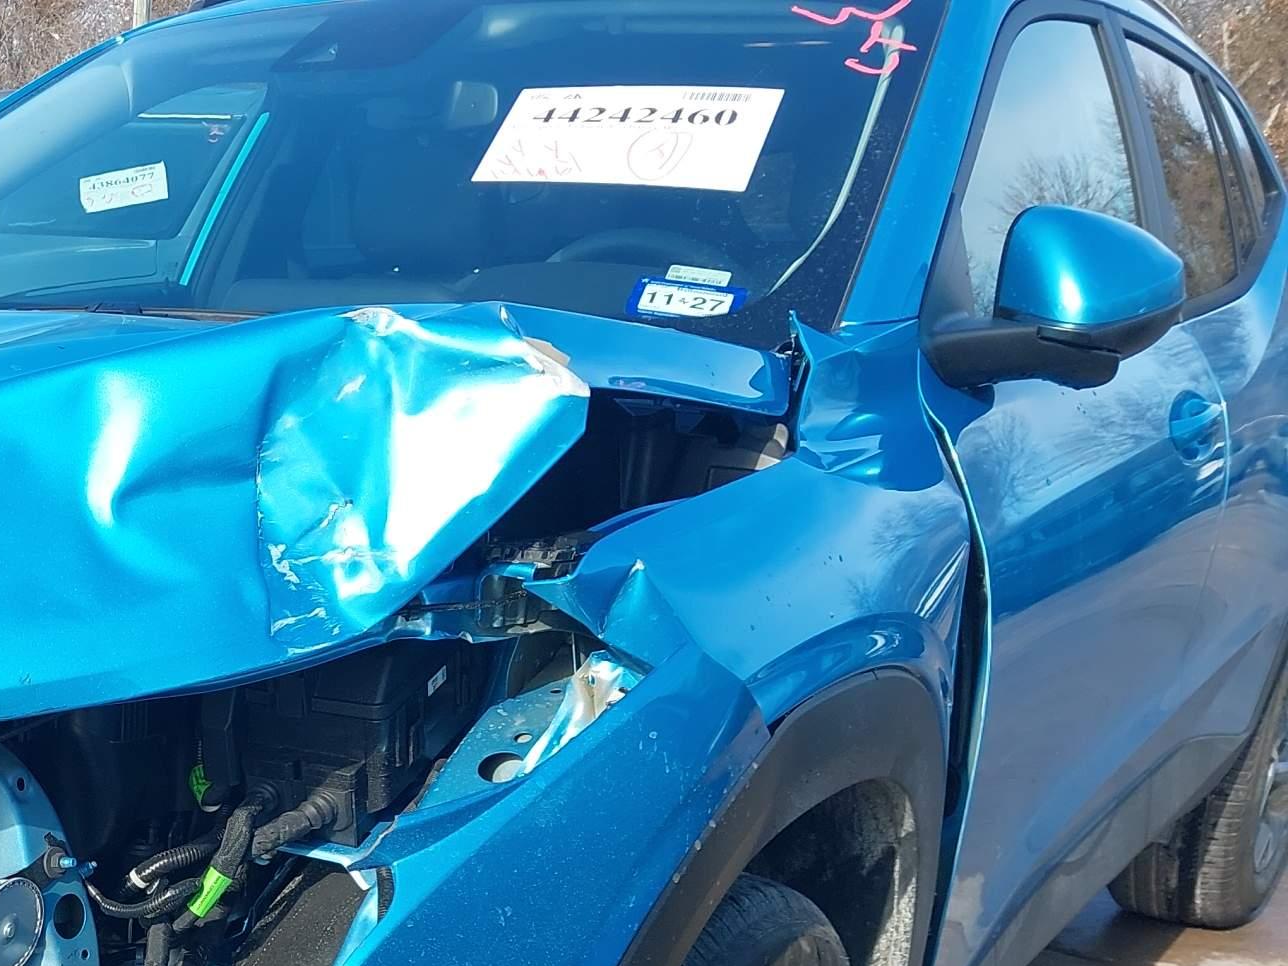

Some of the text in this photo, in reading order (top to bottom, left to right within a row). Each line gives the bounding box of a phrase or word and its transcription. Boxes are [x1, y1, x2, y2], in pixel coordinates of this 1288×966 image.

[532, 107, 738, 126] 44242460
[647, 291, 674, 306] 11
[689, 296, 726, 311] 27
